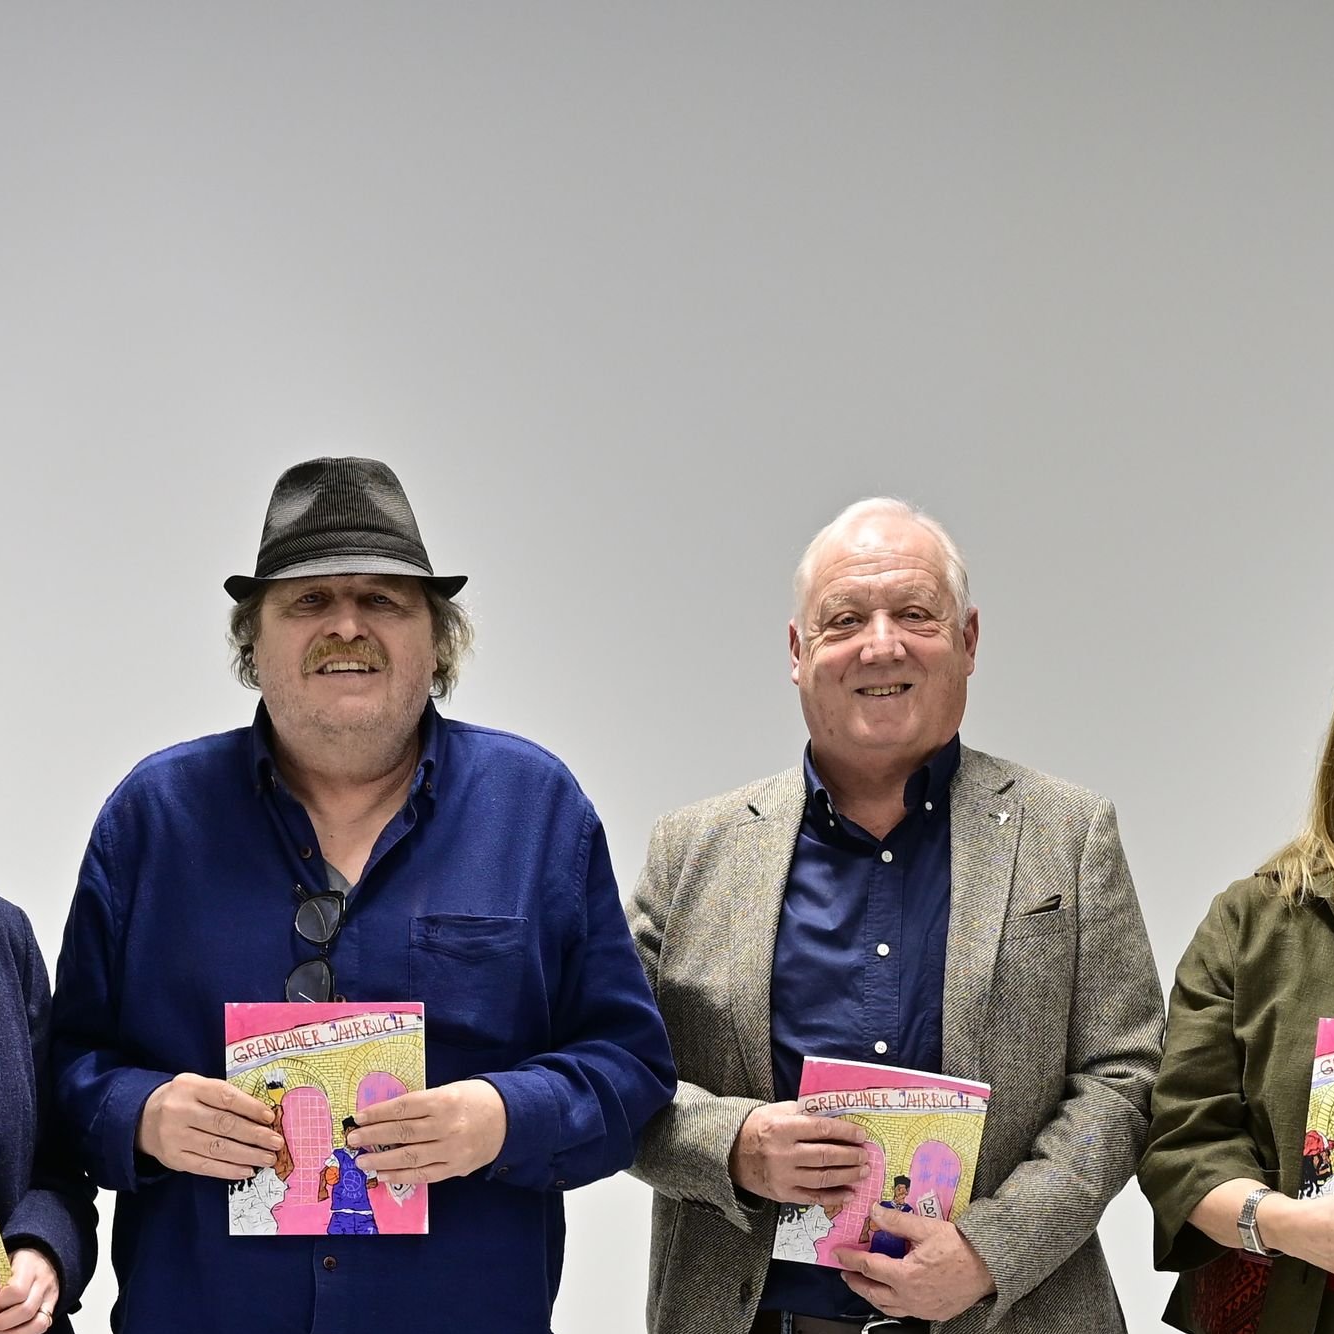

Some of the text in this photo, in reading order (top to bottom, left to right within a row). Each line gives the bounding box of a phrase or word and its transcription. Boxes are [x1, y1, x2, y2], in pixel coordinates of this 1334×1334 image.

[233, 1016, 405, 1063] GRENCHNER JAHRBUCH
[804, 1091, 971, 1114] GRENCHNER JAHRBUCH
